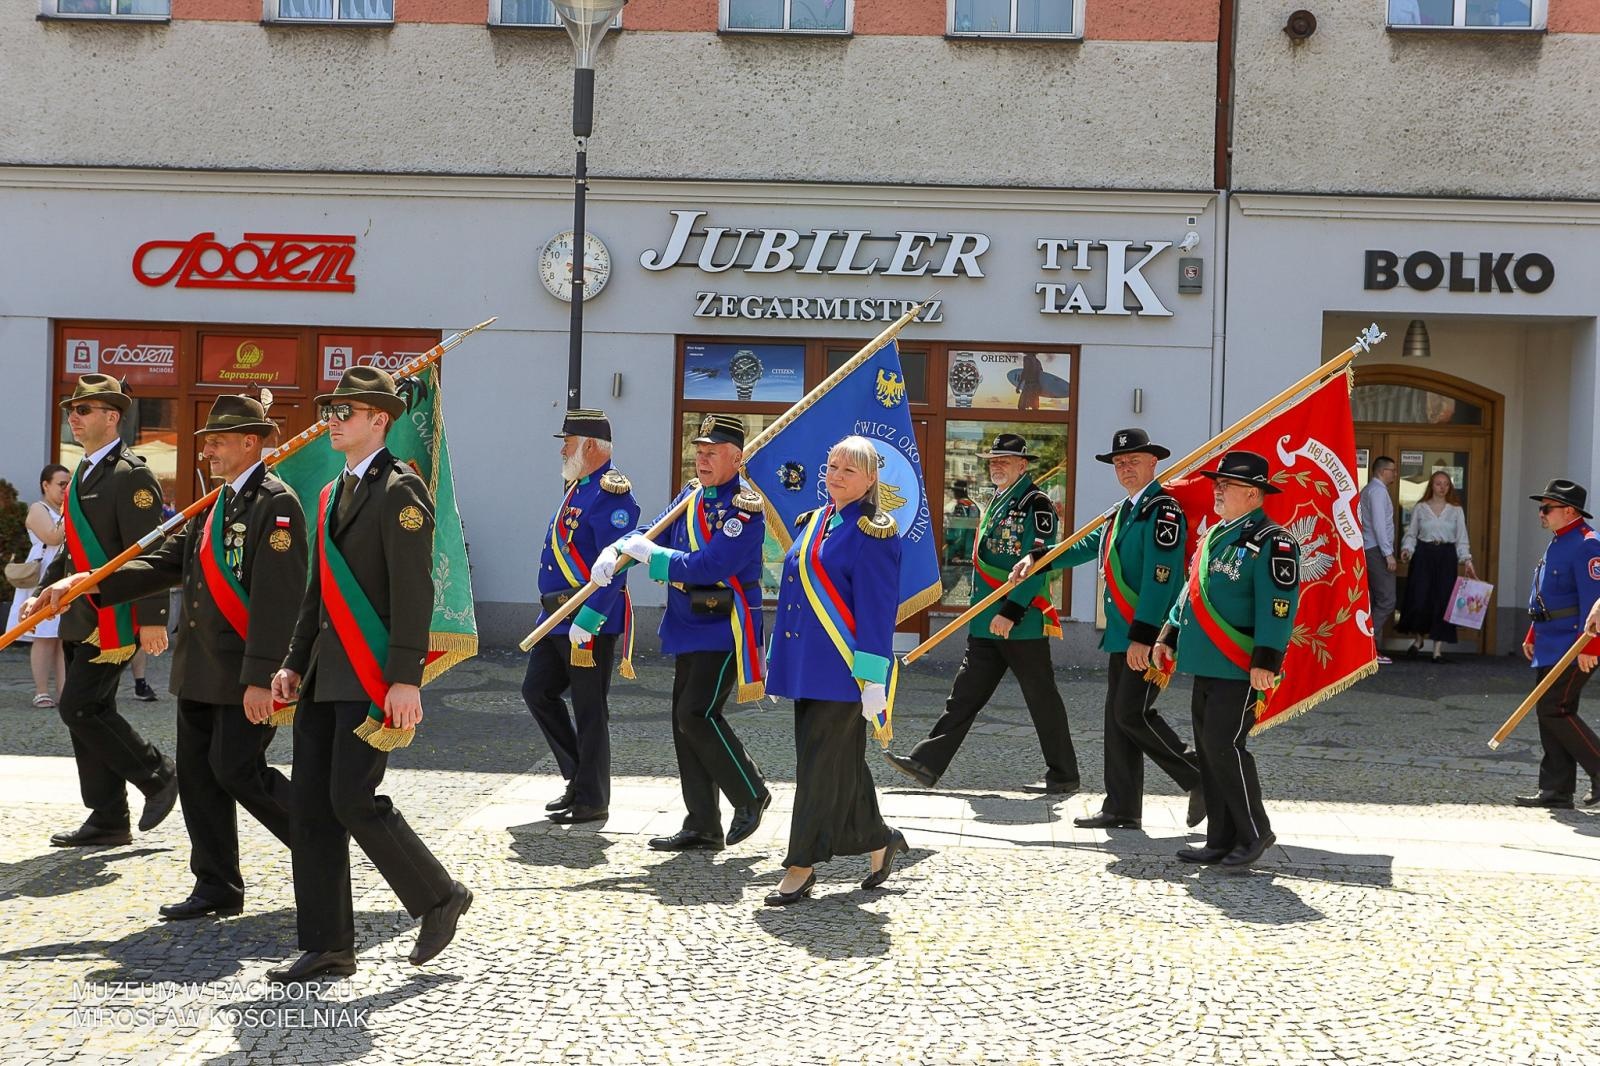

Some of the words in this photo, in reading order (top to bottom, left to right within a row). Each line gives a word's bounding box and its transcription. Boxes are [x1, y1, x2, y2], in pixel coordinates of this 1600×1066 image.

[639, 209, 991, 278] JUBILER
[1364, 250, 1555, 294] BOLKO
[693, 291, 943, 323] ZEGARMISTRZ
[981, 354, 1018, 363] ORIENT
[854, 420, 897, 440] ĆWICZ
[898, 436, 920, 463] OKO
[1307, 442, 1323, 460] Hej
[1320, 452, 1352, 493] Strzelcy
[1337, 510, 1356, 539] wraz
